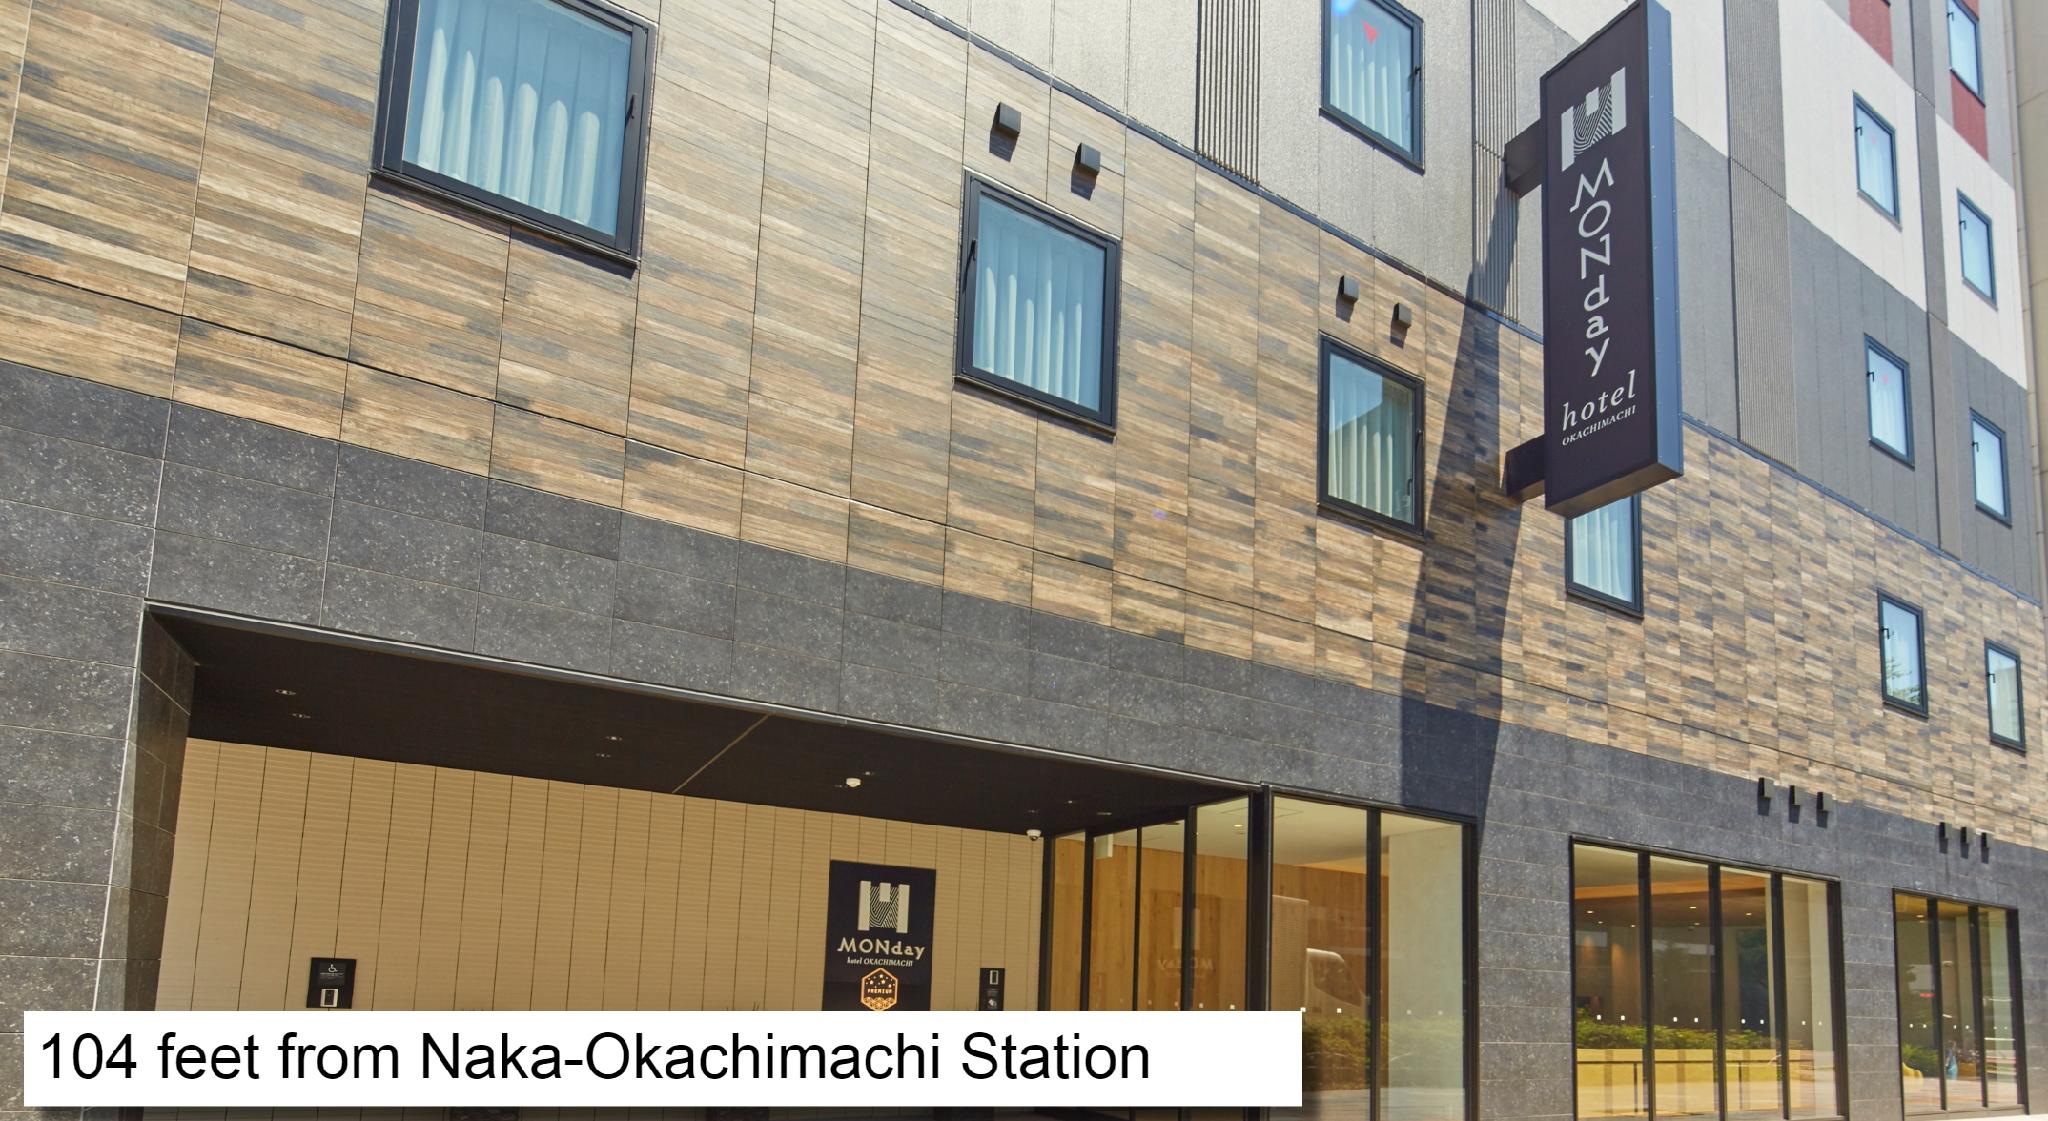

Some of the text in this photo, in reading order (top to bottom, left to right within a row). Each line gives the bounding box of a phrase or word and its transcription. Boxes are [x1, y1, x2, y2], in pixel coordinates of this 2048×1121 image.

[1569, 157, 1615, 378] MONday
[1562, 368, 1636, 432] hotel
[1562, 405, 1636, 446] OKACHIMACHI
[837, 936, 925, 960] MONday
[863, 958, 913, 967] OKACHIMACHI
